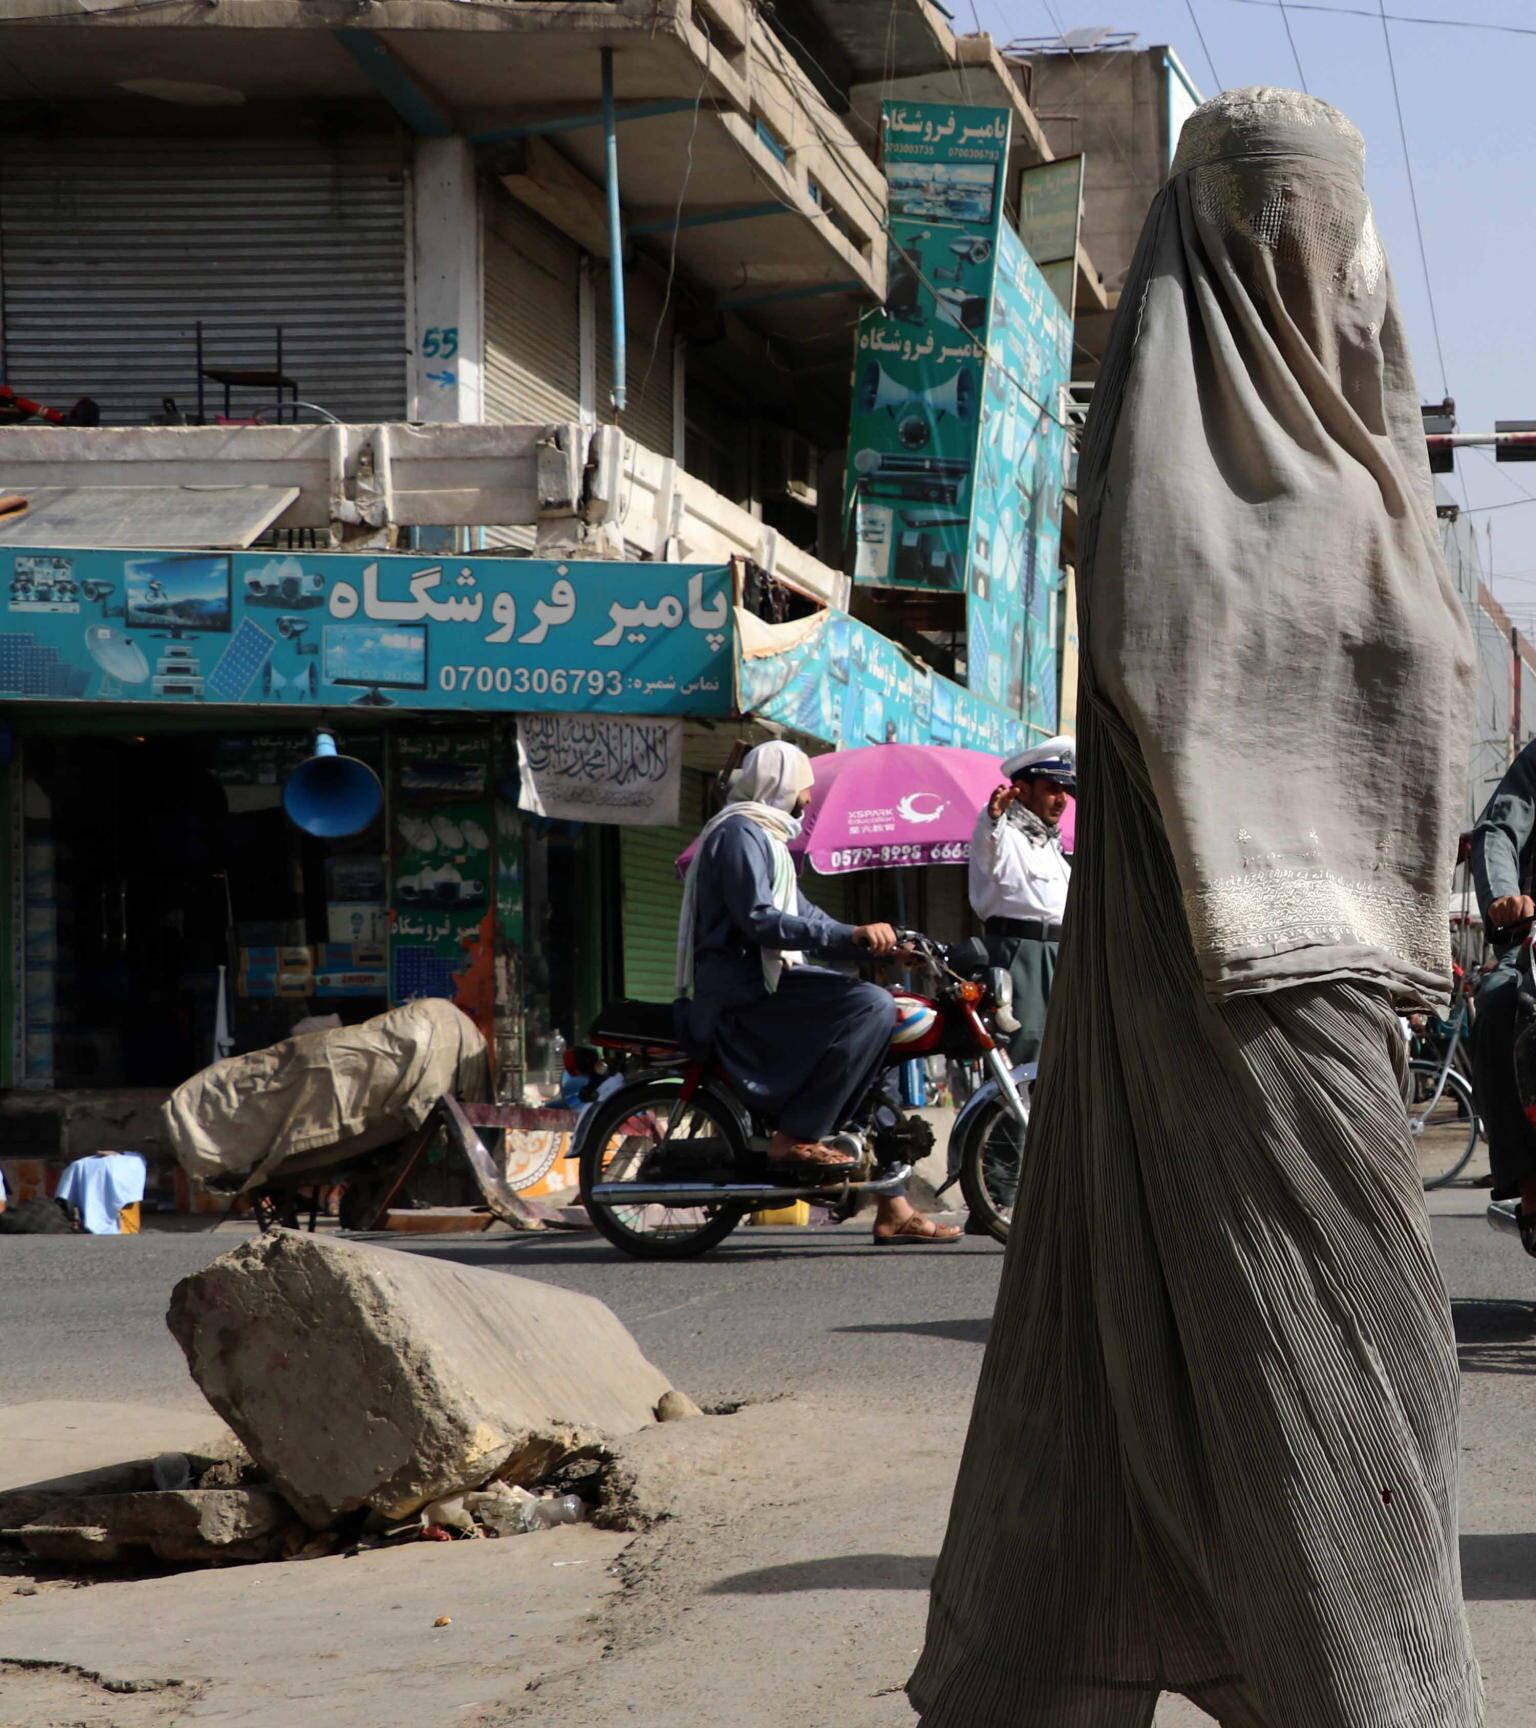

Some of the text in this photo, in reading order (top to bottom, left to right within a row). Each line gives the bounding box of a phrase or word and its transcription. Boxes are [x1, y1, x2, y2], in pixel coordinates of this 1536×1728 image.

[422, 326, 458, 359] 55
[328, 562, 728, 652] پامیر فروشگاه
[439, 665, 623, 696] 0700306793
[847, 809, 894, 819] XSPARK
